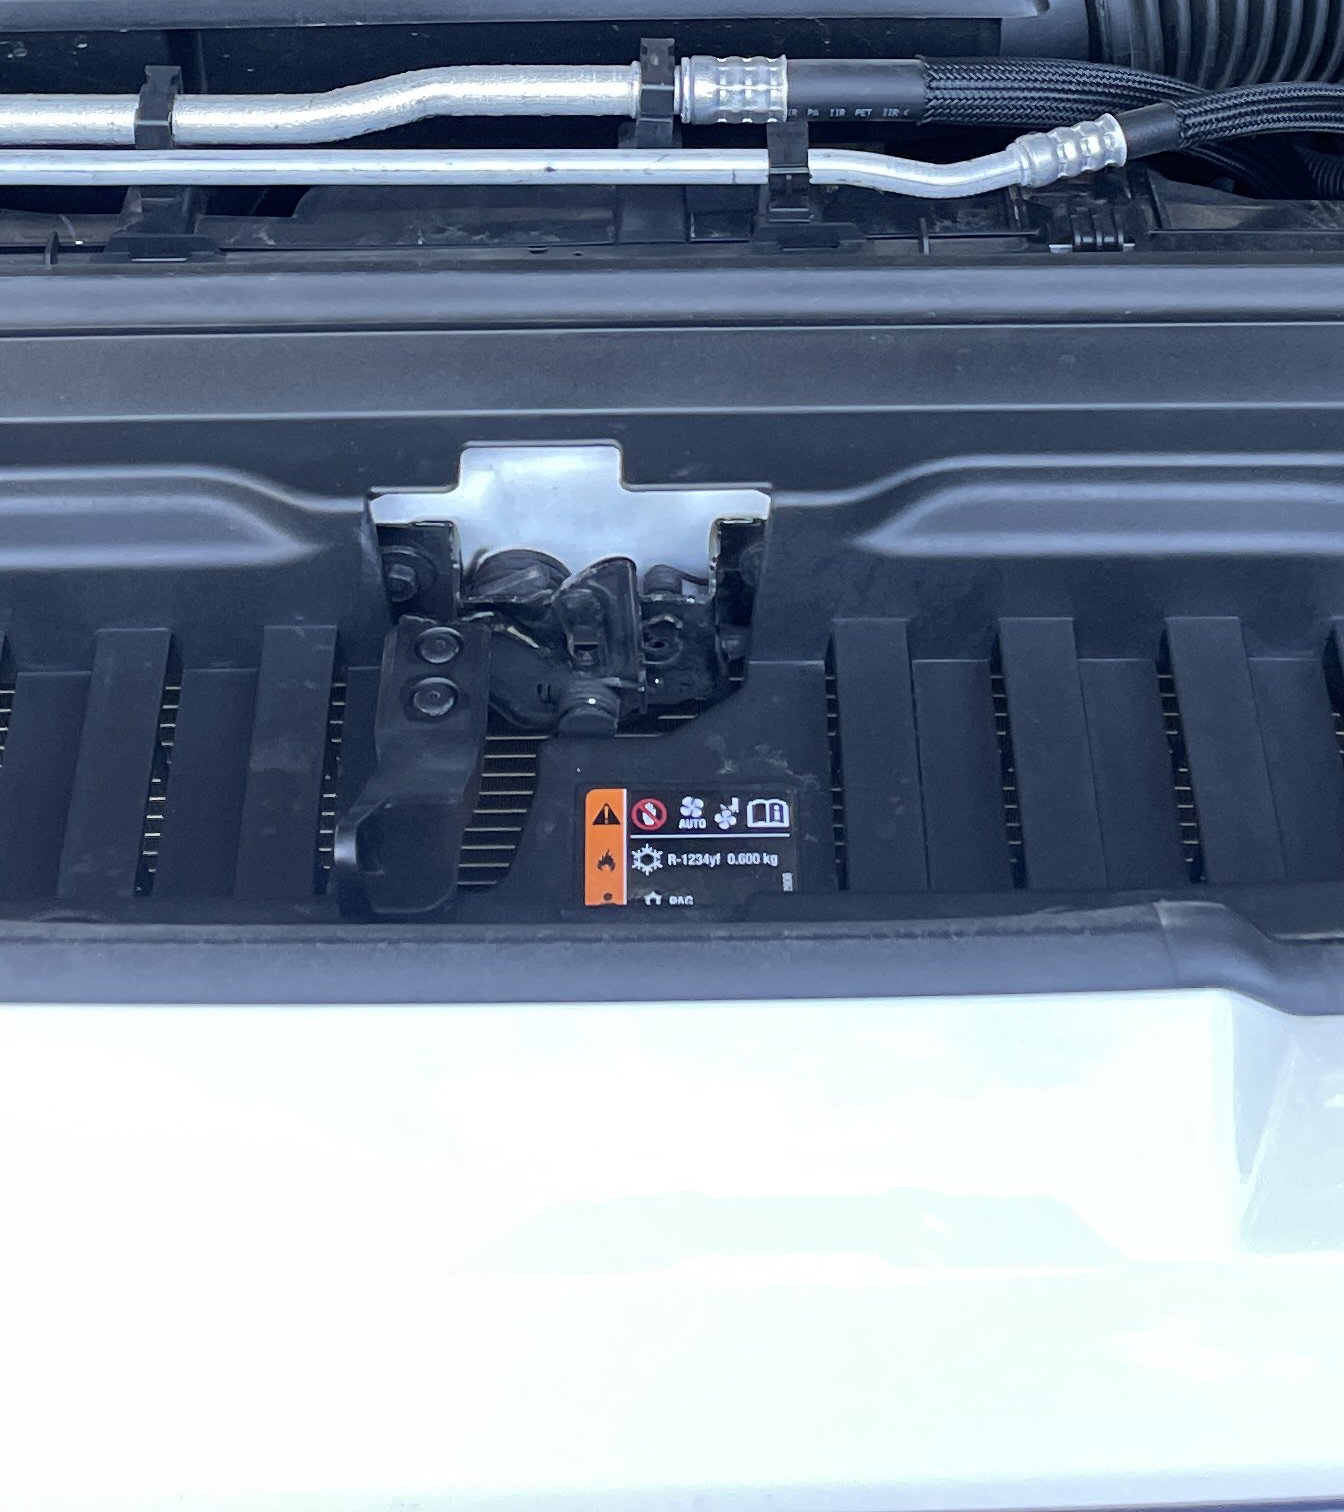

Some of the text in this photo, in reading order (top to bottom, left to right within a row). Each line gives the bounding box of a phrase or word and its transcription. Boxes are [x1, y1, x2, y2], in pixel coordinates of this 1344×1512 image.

[855, 108, 872, 116] PET
[678, 818, 707, 829] AUTO
[667, 853, 778, 867] R-1234yf 0.600 kg
